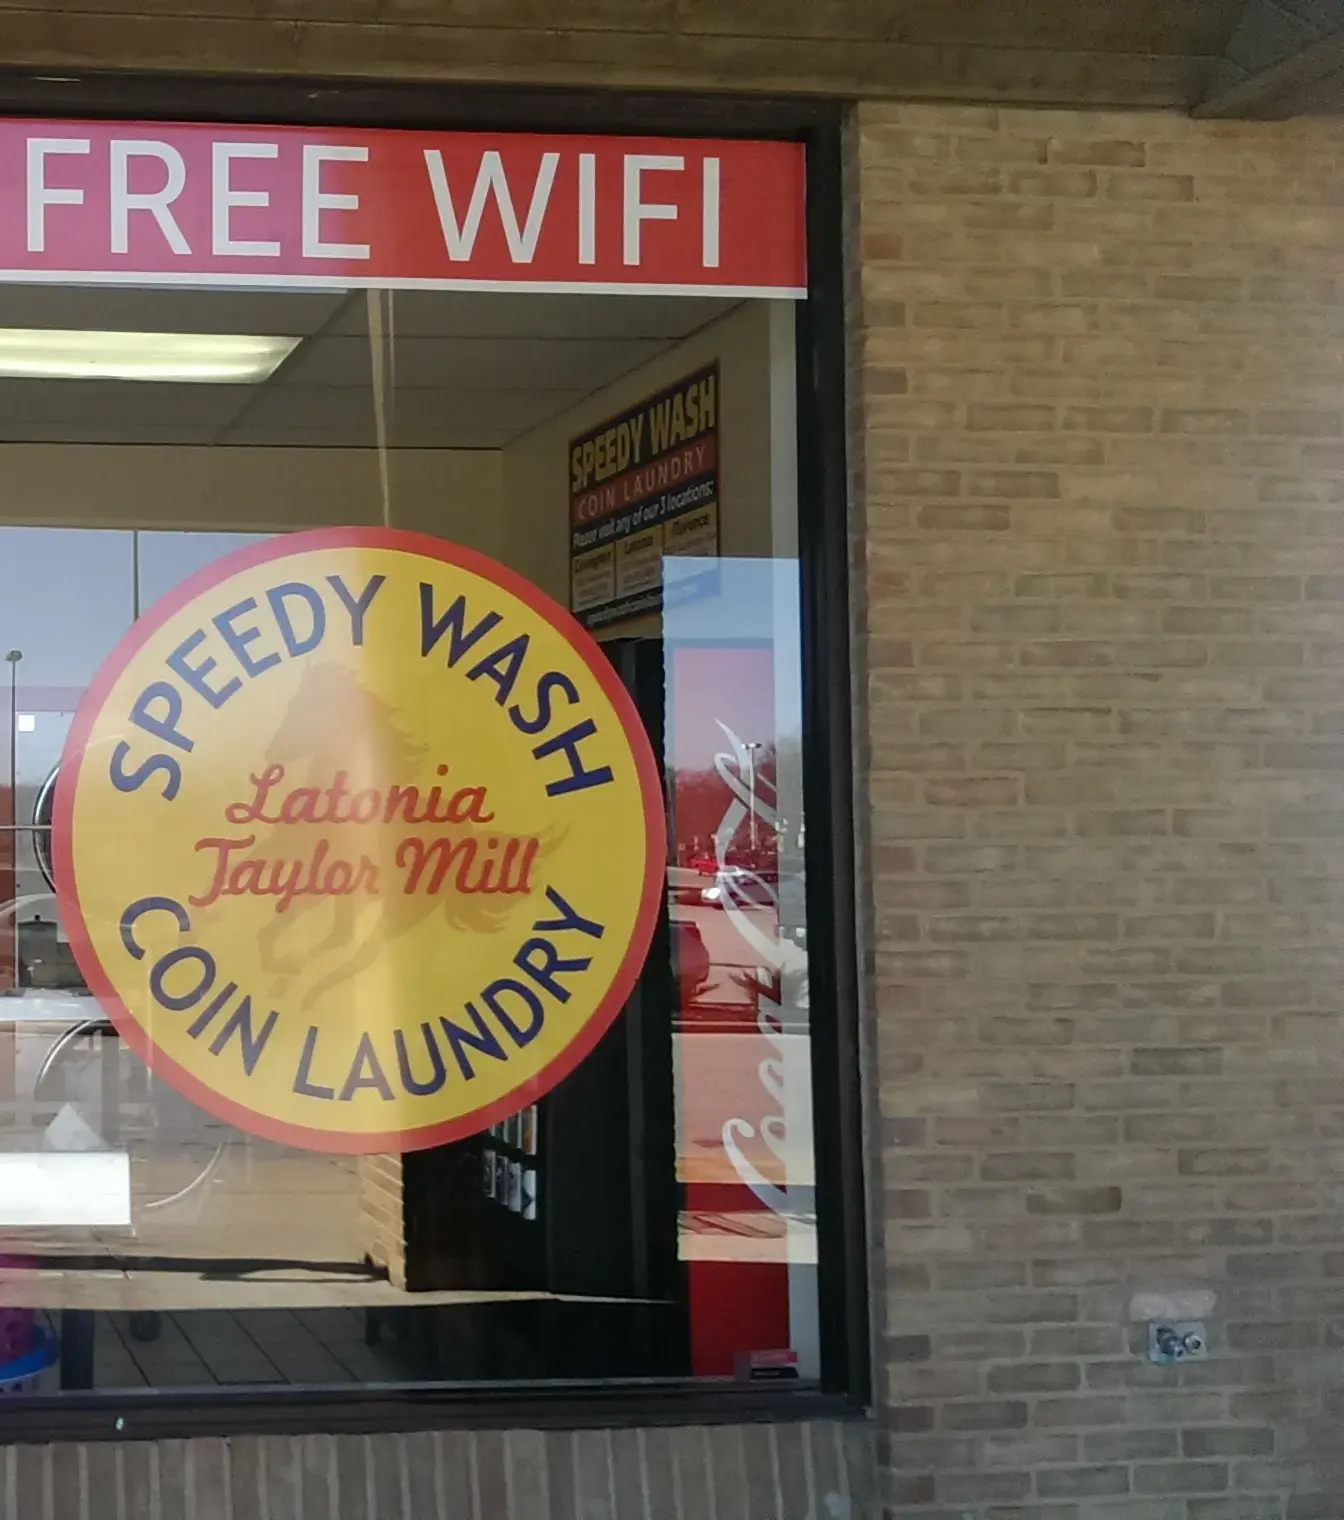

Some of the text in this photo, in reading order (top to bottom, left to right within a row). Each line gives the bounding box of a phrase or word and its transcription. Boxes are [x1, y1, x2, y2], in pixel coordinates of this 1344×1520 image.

[25, 137, 721, 268] FREE WIFI
[572, 374, 716, 493] SPEEDY WASH
[576, 443, 706, 521] COIN LAUNDRY
[109, 575, 615, 802] SPEEDY WASH
[225, 764, 495, 825] Latonia
[188, 836, 540, 914] Taylor Mill
[120, 886, 606, 1103] COIN LAUNDRY
